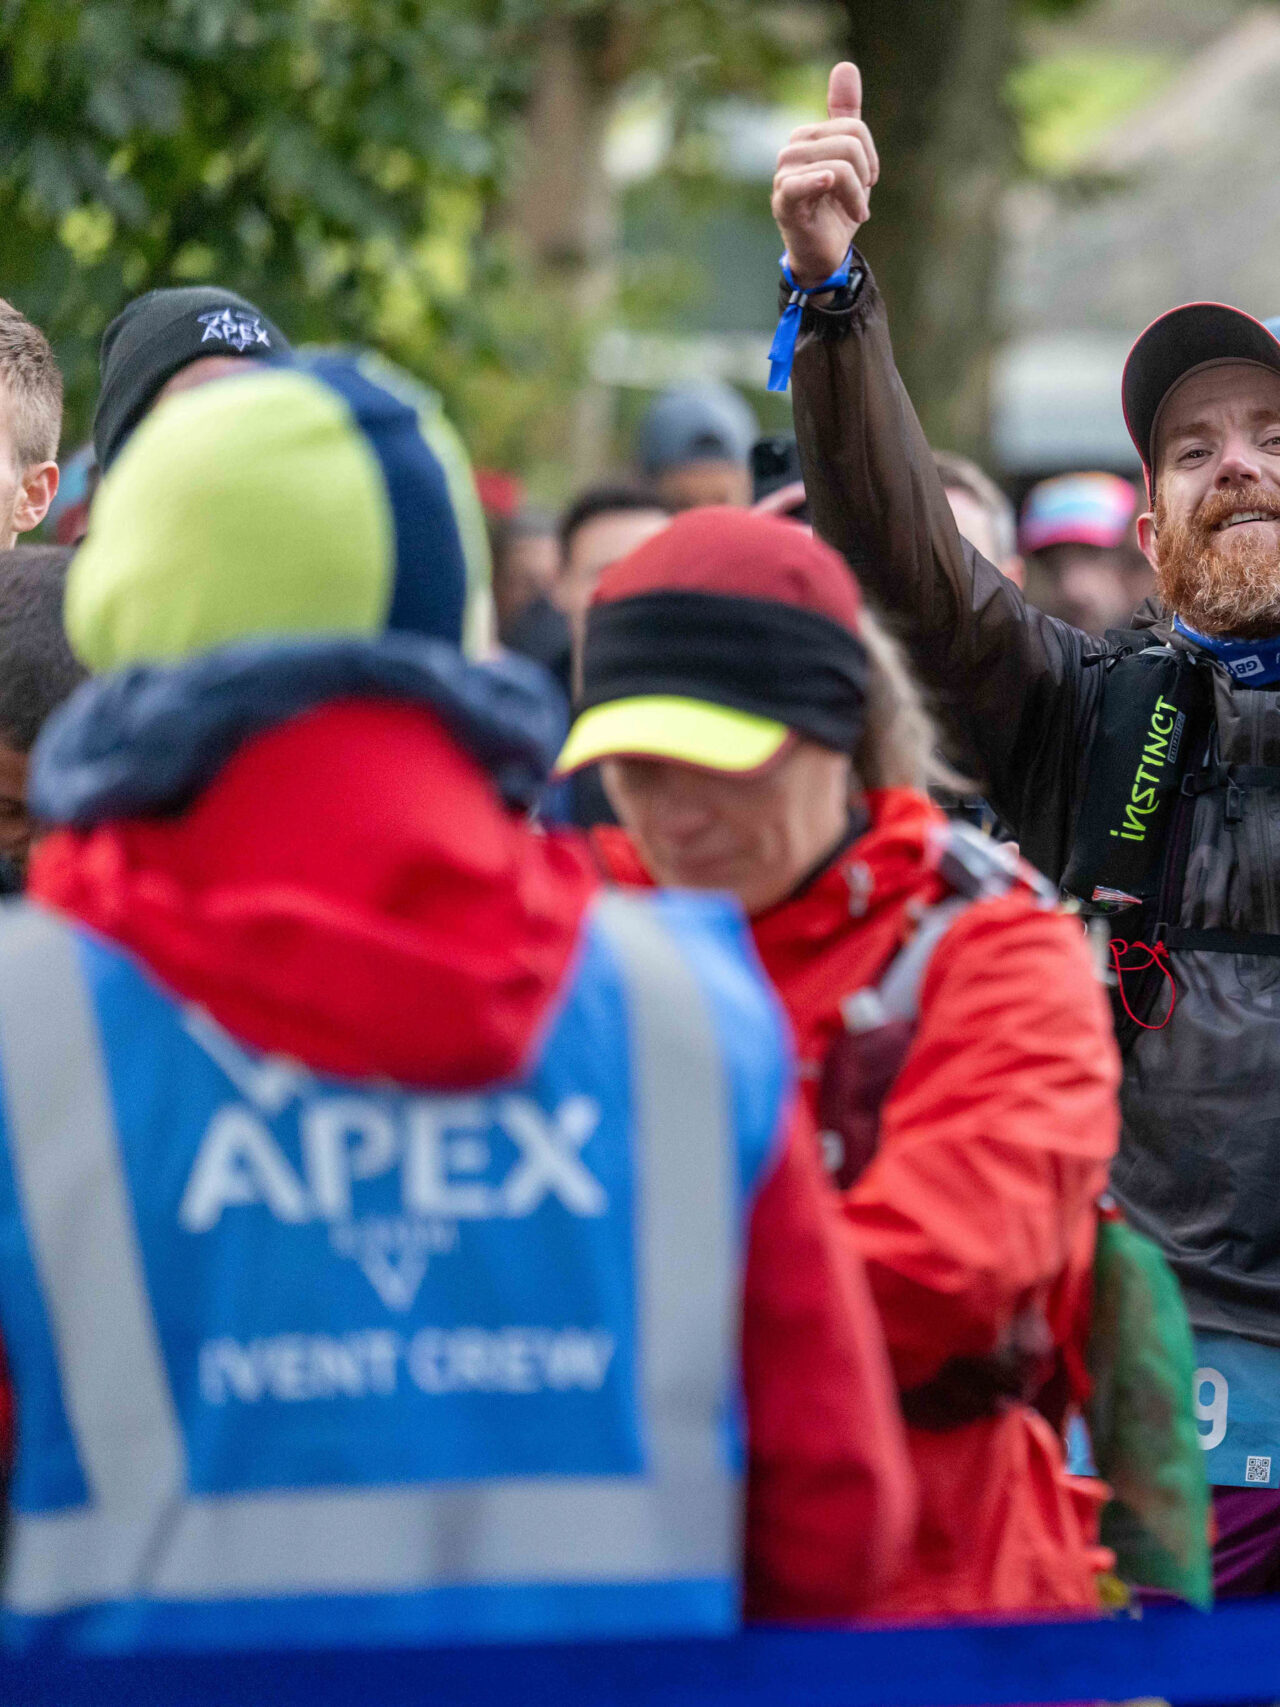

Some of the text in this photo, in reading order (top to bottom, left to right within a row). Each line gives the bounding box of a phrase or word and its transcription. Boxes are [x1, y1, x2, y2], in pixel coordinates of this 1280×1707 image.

[200, 320, 271, 347] APEX
[1235, 660, 1258, 674] GB
[178, 1097, 609, 1233] APEX
[407, 1327, 615, 1395] CREW
